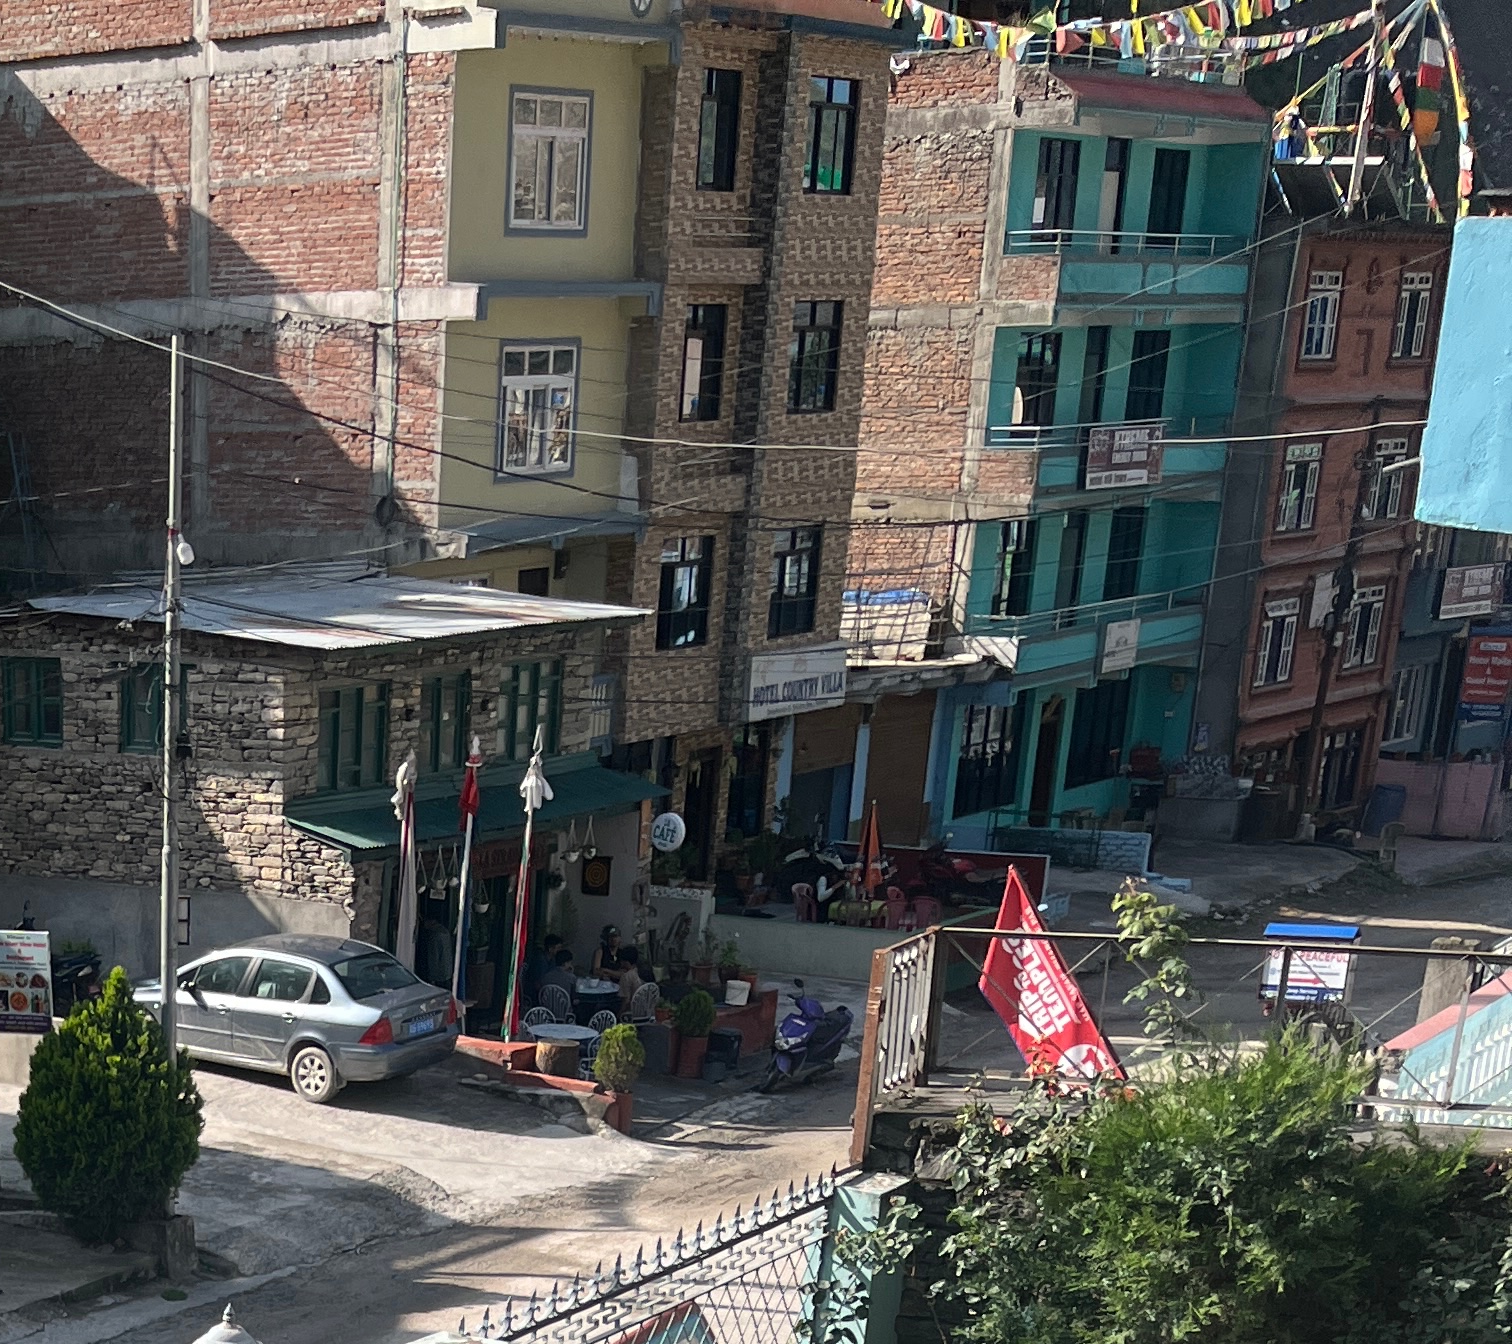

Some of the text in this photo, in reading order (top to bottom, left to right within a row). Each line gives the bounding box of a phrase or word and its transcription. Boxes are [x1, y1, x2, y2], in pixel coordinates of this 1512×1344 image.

[752, 684, 779, 708] HOTEL
[821, 671, 843, 695] VILLA
[1021, 989, 1057, 1038] TRIP
